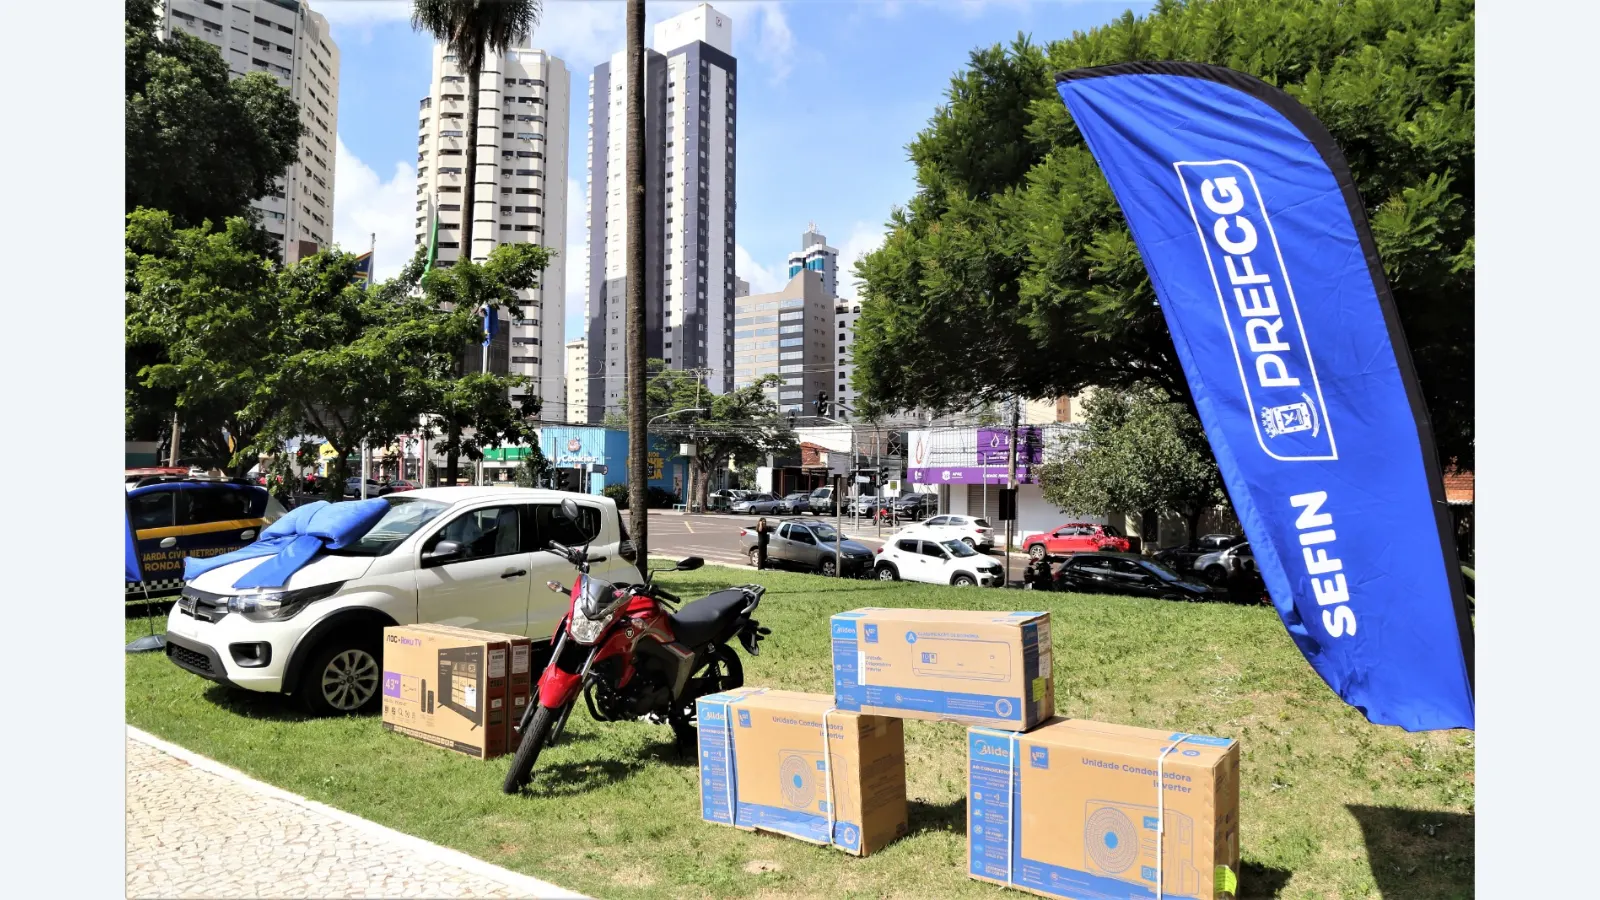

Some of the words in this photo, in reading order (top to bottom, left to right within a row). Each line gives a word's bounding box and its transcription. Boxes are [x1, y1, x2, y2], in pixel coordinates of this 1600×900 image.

[1200, 176, 1301, 388] PREFCG
[143, 552, 167, 562] ARDA
[1290, 490, 1357, 638] SEFIN
[144, 561, 181, 572] RONDA
[772, 716, 798, 725] Unidade
[978, 742, 1015, 758] Mide
[1081, 757, 1120, 770] Unidade
[1122, 764, 1192, 783] Condenadora
